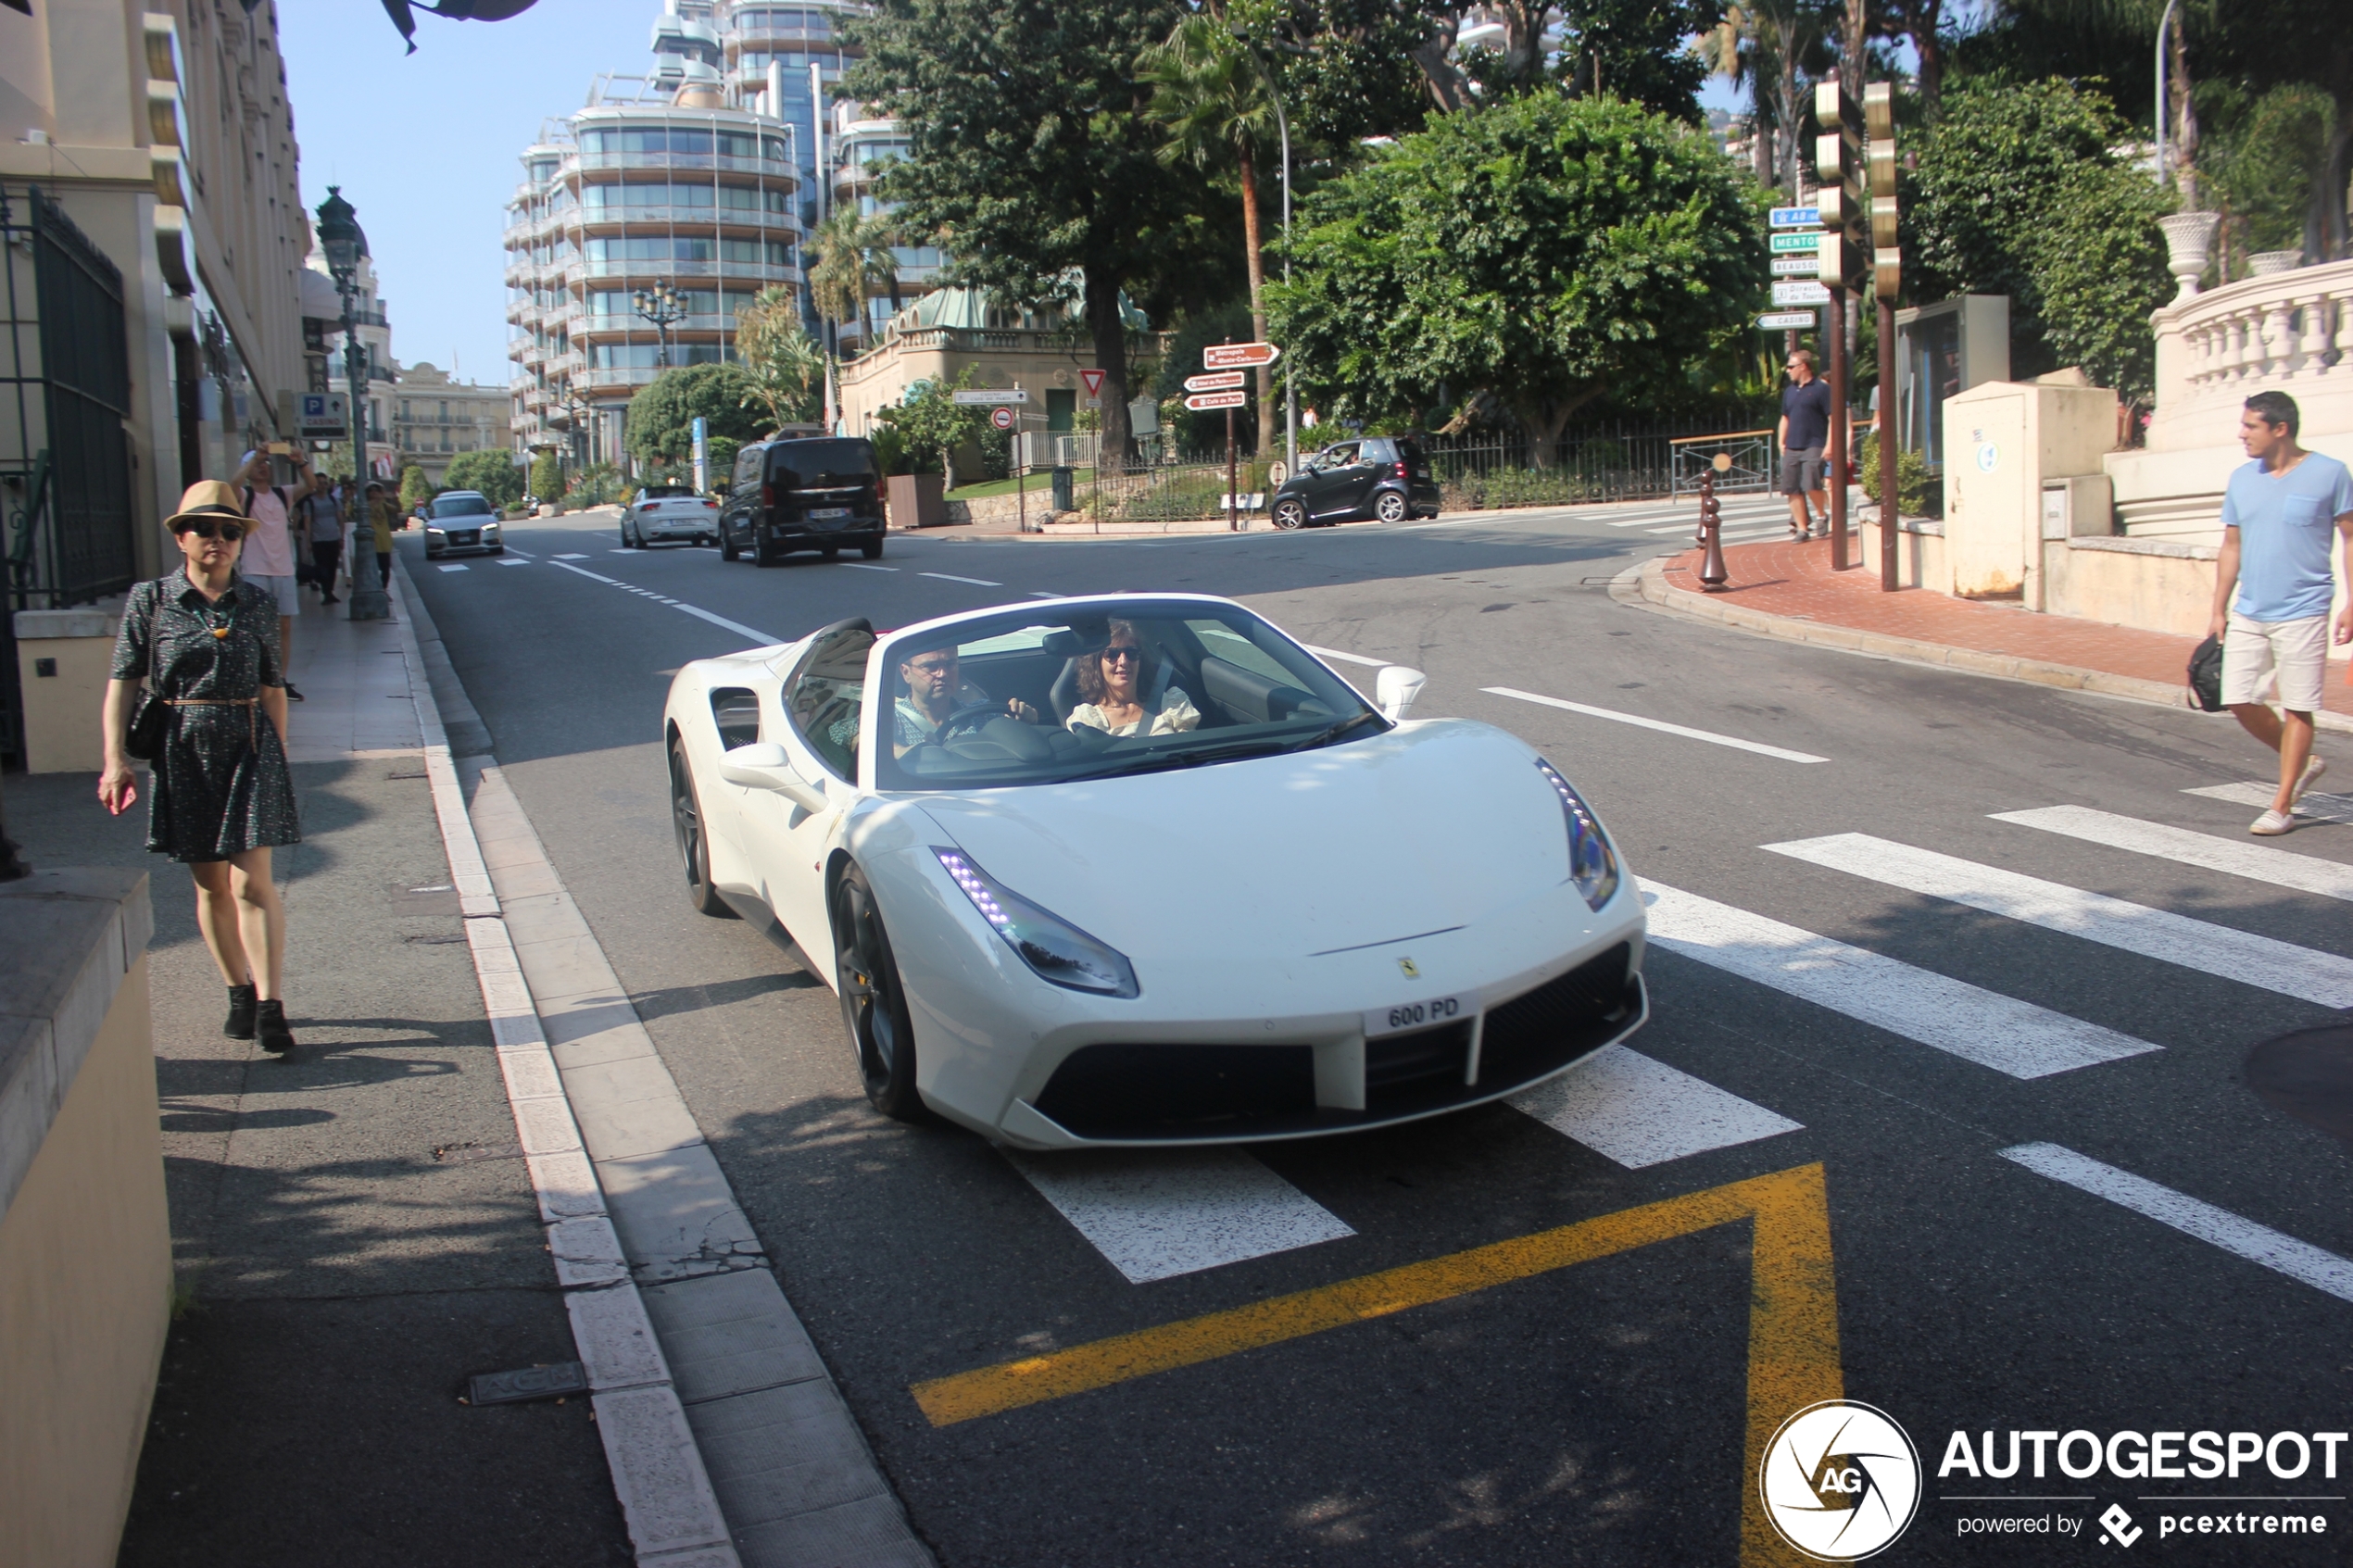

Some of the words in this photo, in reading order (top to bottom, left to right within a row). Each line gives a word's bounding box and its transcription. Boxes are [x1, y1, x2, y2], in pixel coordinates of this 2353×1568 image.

[1792, 211, 1806, 221] A8
[1777, 236, 1818, 247] MENTO
[1778, 316, 1810, 324] CASINO
[307, 418, 340, 426] CASINO
[1389, 1005, 1425, 1027] 600
[1430, 998, 1459, 1020] PD
